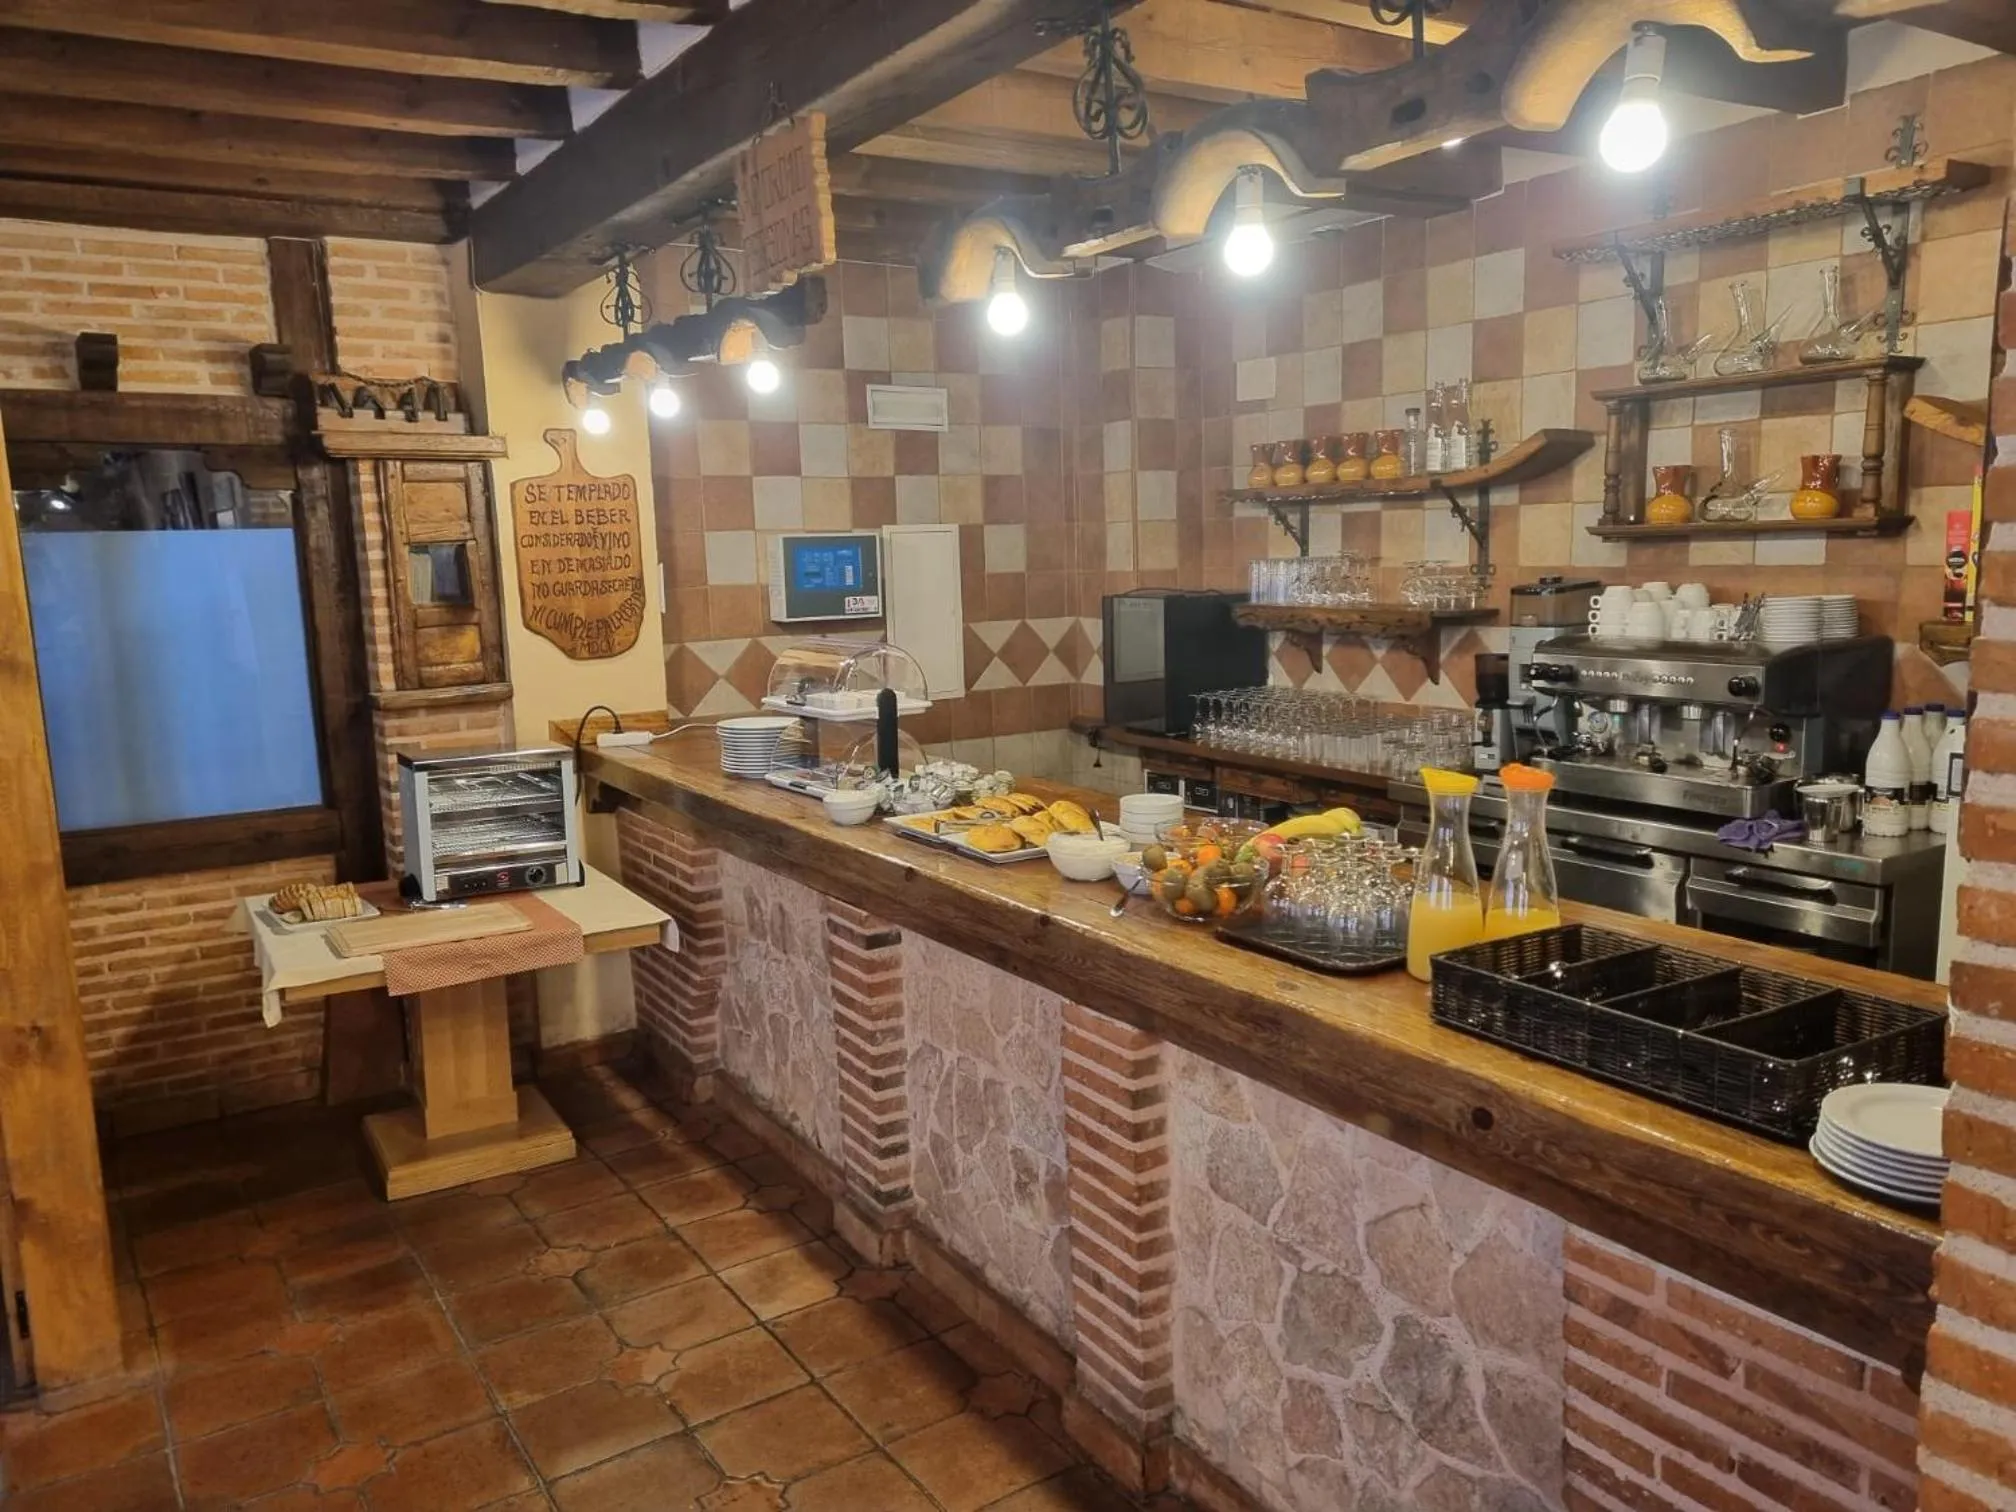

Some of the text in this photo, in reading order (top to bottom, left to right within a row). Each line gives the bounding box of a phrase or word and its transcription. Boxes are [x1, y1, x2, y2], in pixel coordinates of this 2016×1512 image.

[525, 483, 631, 504] SE TEMPLADO
[574, 508, 632, 526] BEBER
[530, 559, 552, 576] EN
